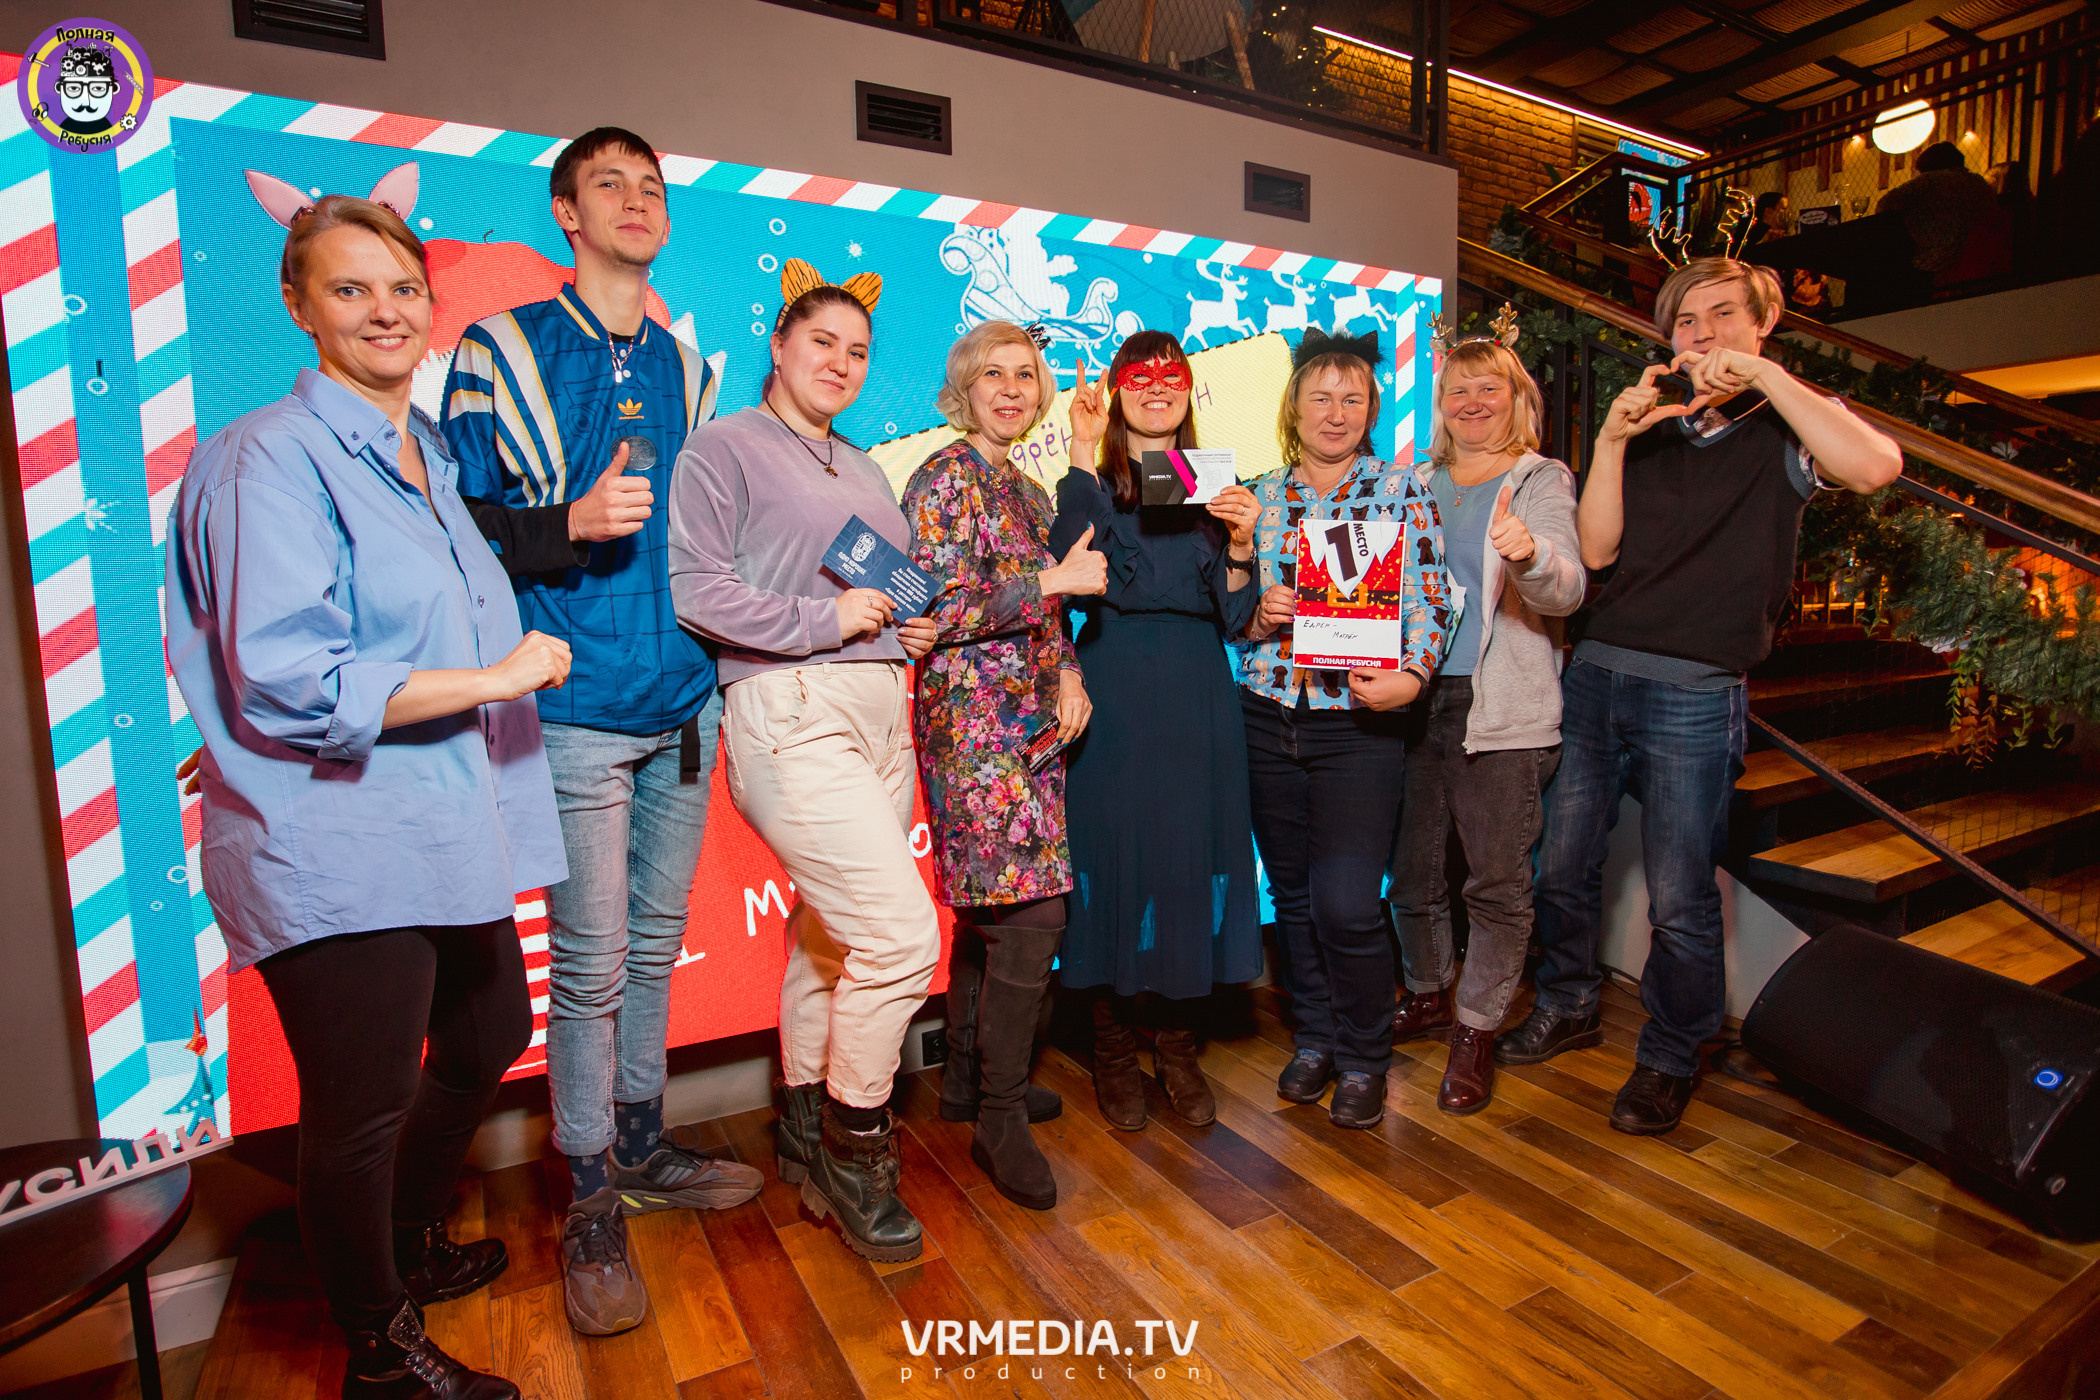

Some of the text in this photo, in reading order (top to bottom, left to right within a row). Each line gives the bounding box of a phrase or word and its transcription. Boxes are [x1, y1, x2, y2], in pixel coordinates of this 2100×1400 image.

[1012, 422, 1073, 479] дрён
[1324, 522, 1369, 582] 1 МЕСТО
[1312, 657, 1382, 668] ПОЛНАЯ РЕБУСНЯ
